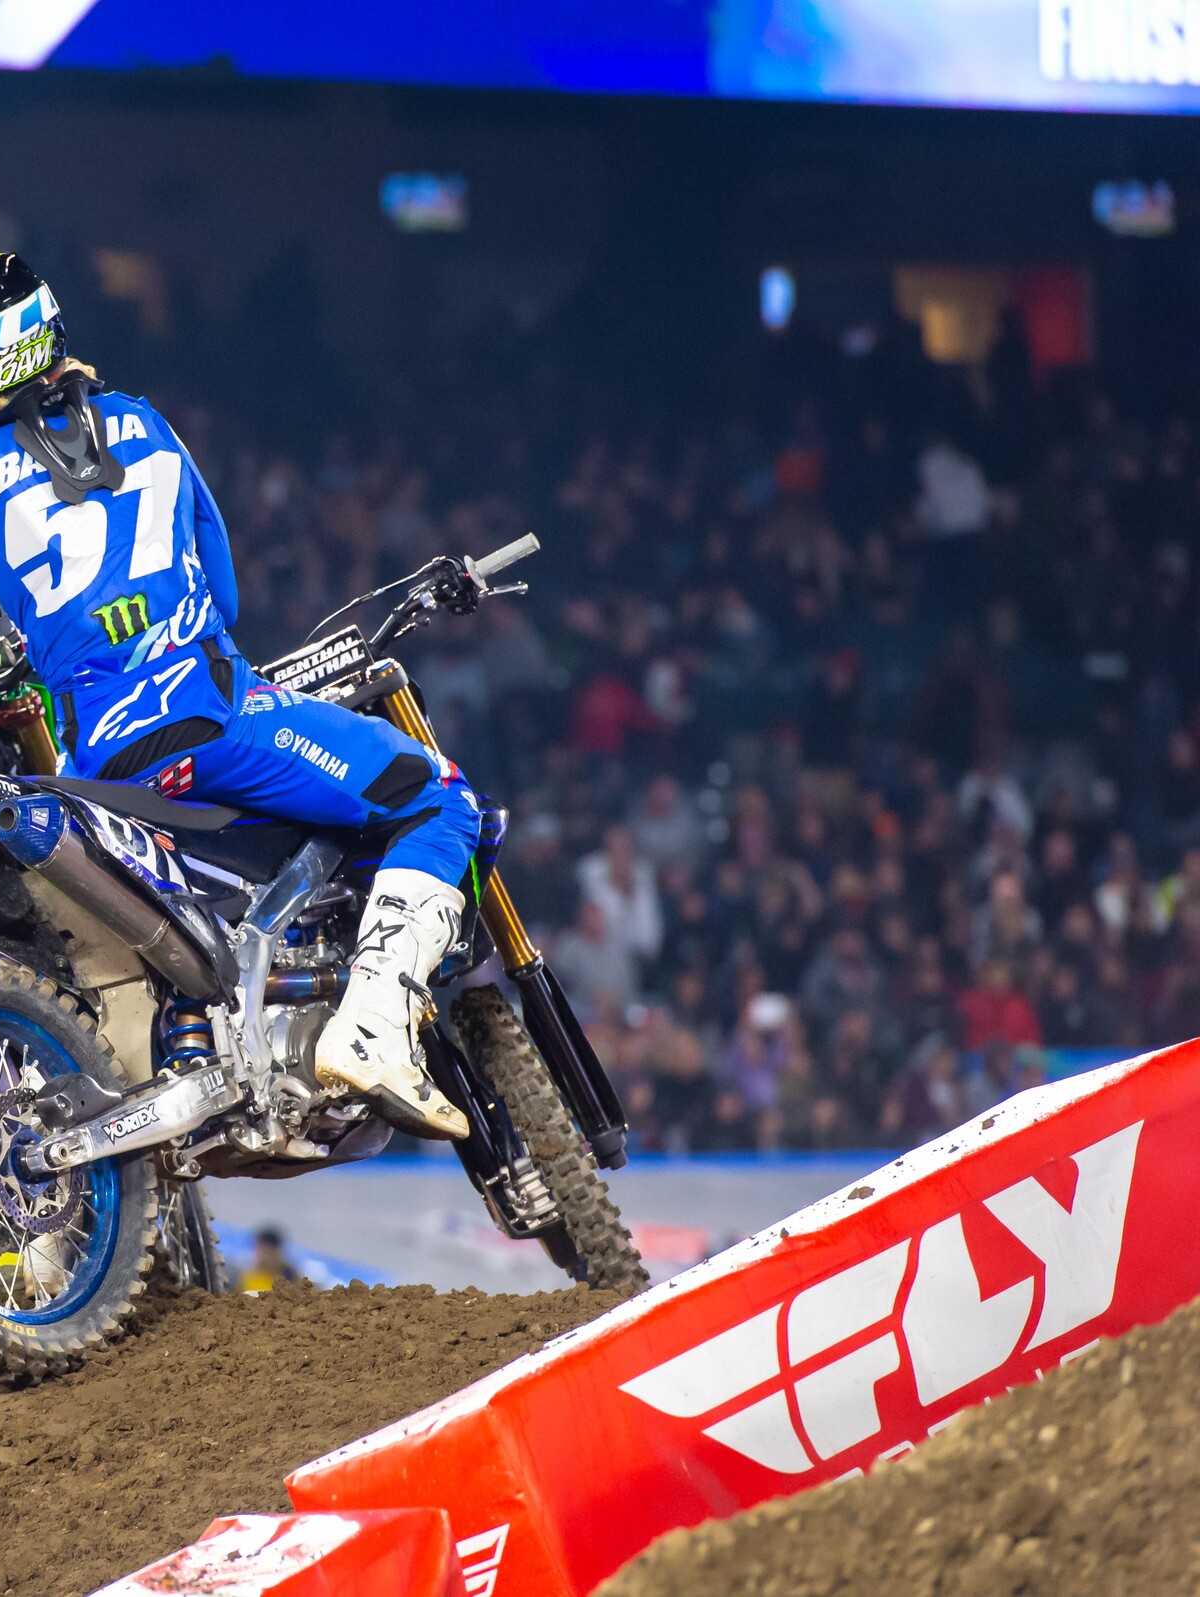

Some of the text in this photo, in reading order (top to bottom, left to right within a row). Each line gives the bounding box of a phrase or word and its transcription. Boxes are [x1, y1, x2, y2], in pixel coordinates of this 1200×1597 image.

[274, 636, 364, 684] RENTHAL
[282, 648, 366, 691] RENTHAL
[291, 734, 350, 781] YAMAHA
[102, 1104, 160, 1144] VORTEX
[619, 1120, 1145, 1475] FLY
